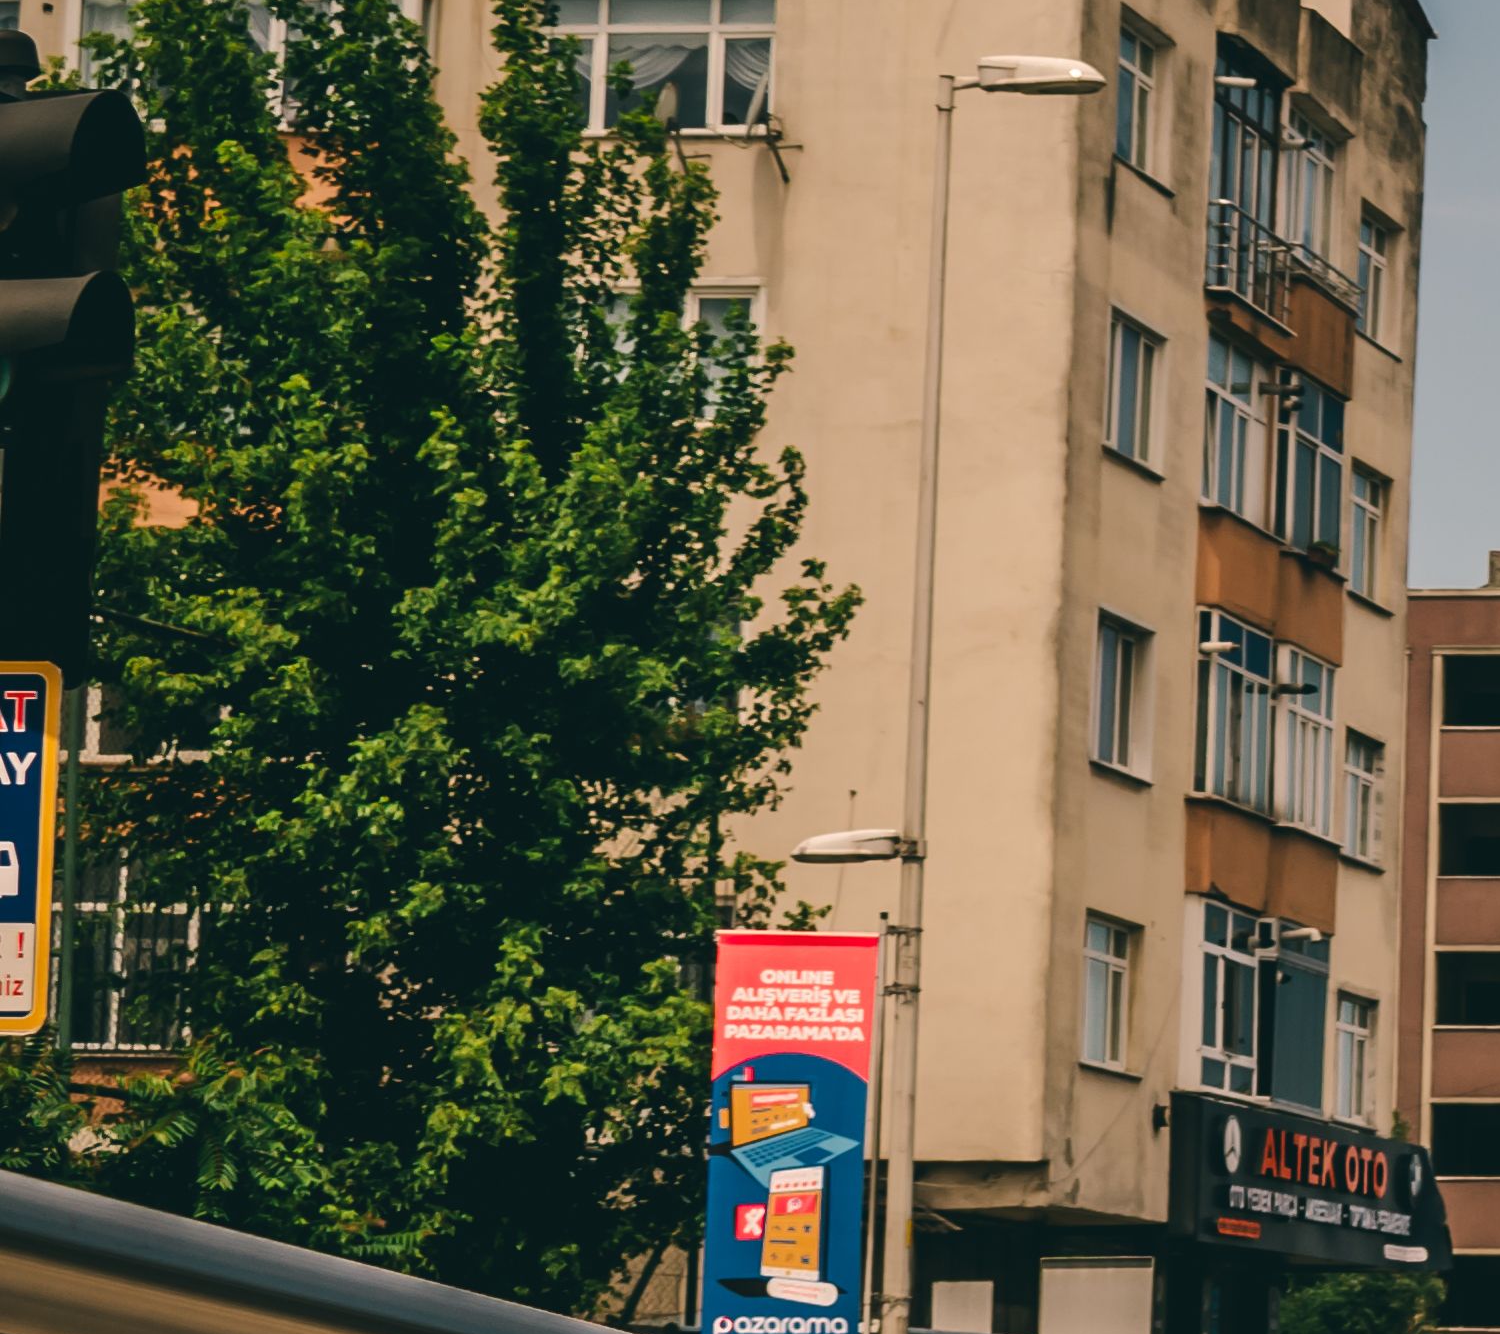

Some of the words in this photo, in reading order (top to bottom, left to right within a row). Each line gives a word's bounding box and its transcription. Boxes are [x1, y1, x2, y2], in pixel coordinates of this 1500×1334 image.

[759, 969, 835, 986] ONLINE
[731, 985, 832, 1008] ALIŞVERİŞ
[833, 989, 861, 1005] VE
[725, 1005, 783, 1022] DAHA
[784, 1007, 865, 1023] FAZLASI
[723, 1023, 865, 1042] PAZARAMA'DA
[1260, 1127, 1338, 1189] ALTEK
[1345, 1144, 1389, 1200] OTO
